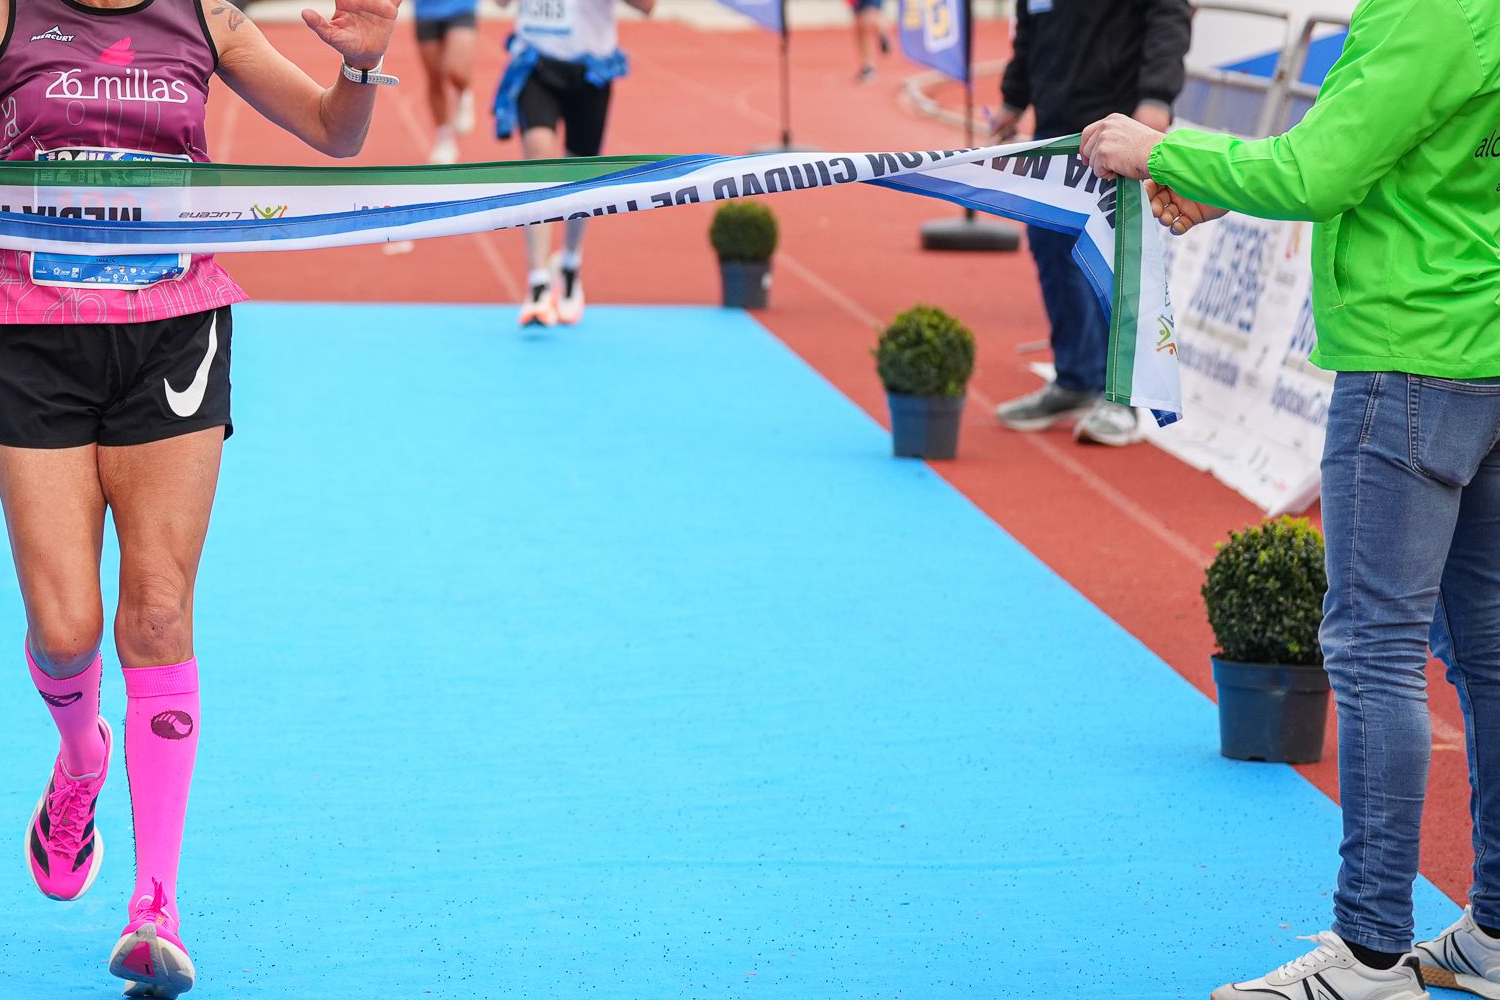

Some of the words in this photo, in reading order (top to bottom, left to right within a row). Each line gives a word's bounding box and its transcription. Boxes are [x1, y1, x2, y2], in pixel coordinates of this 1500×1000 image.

[31, 31, 75, 42] MERCURY
[45, 68, 83, 99] 26
[94, 68, 189, 103] millas
[179, 210, 243, 220] Lucena
